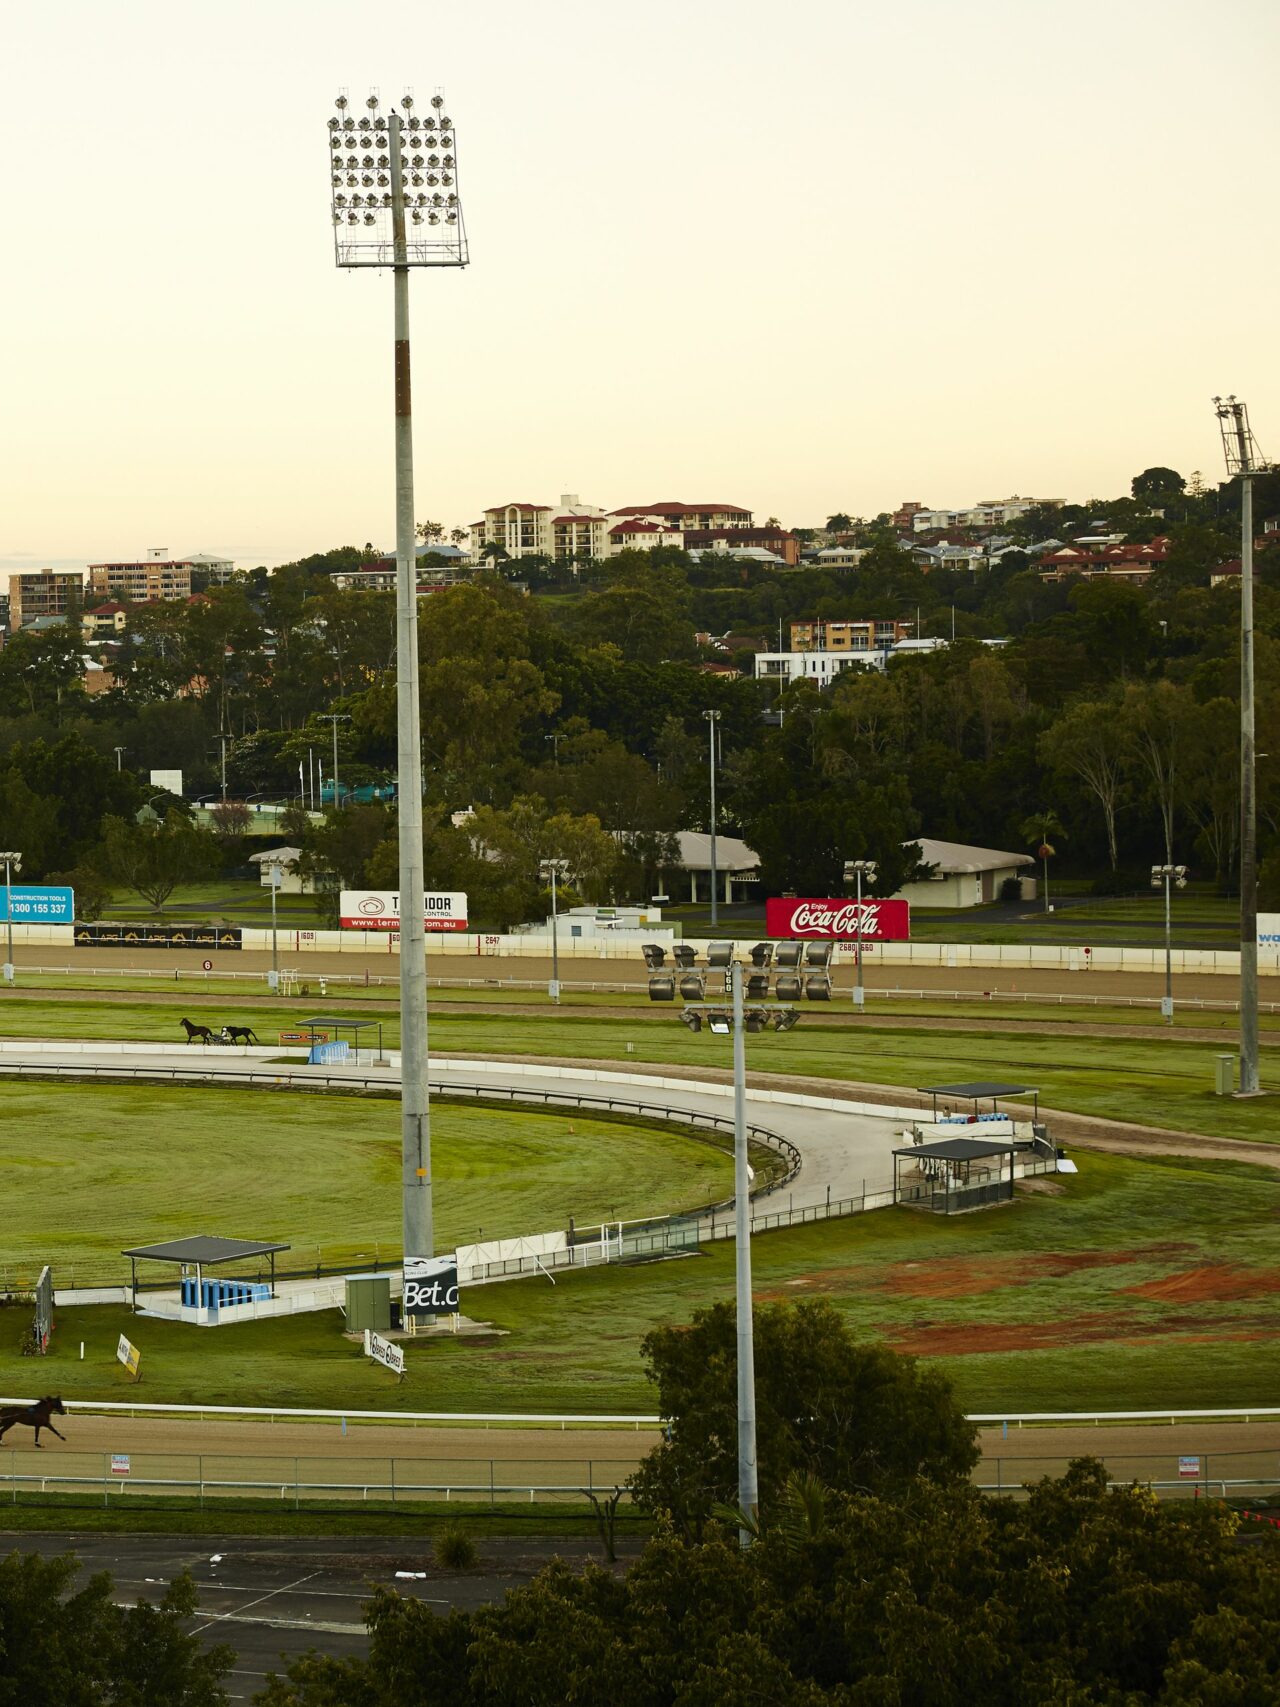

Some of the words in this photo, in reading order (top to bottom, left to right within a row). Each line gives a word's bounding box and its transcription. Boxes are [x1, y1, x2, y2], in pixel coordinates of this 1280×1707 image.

[10, 903, 31, 913] 1300
[33, 904, 48, 913] 155
[50, 904, 66, 914] 337
[392, 896, 451, 911] TIDOR
[810, 903, 828, 911] Enjoy
